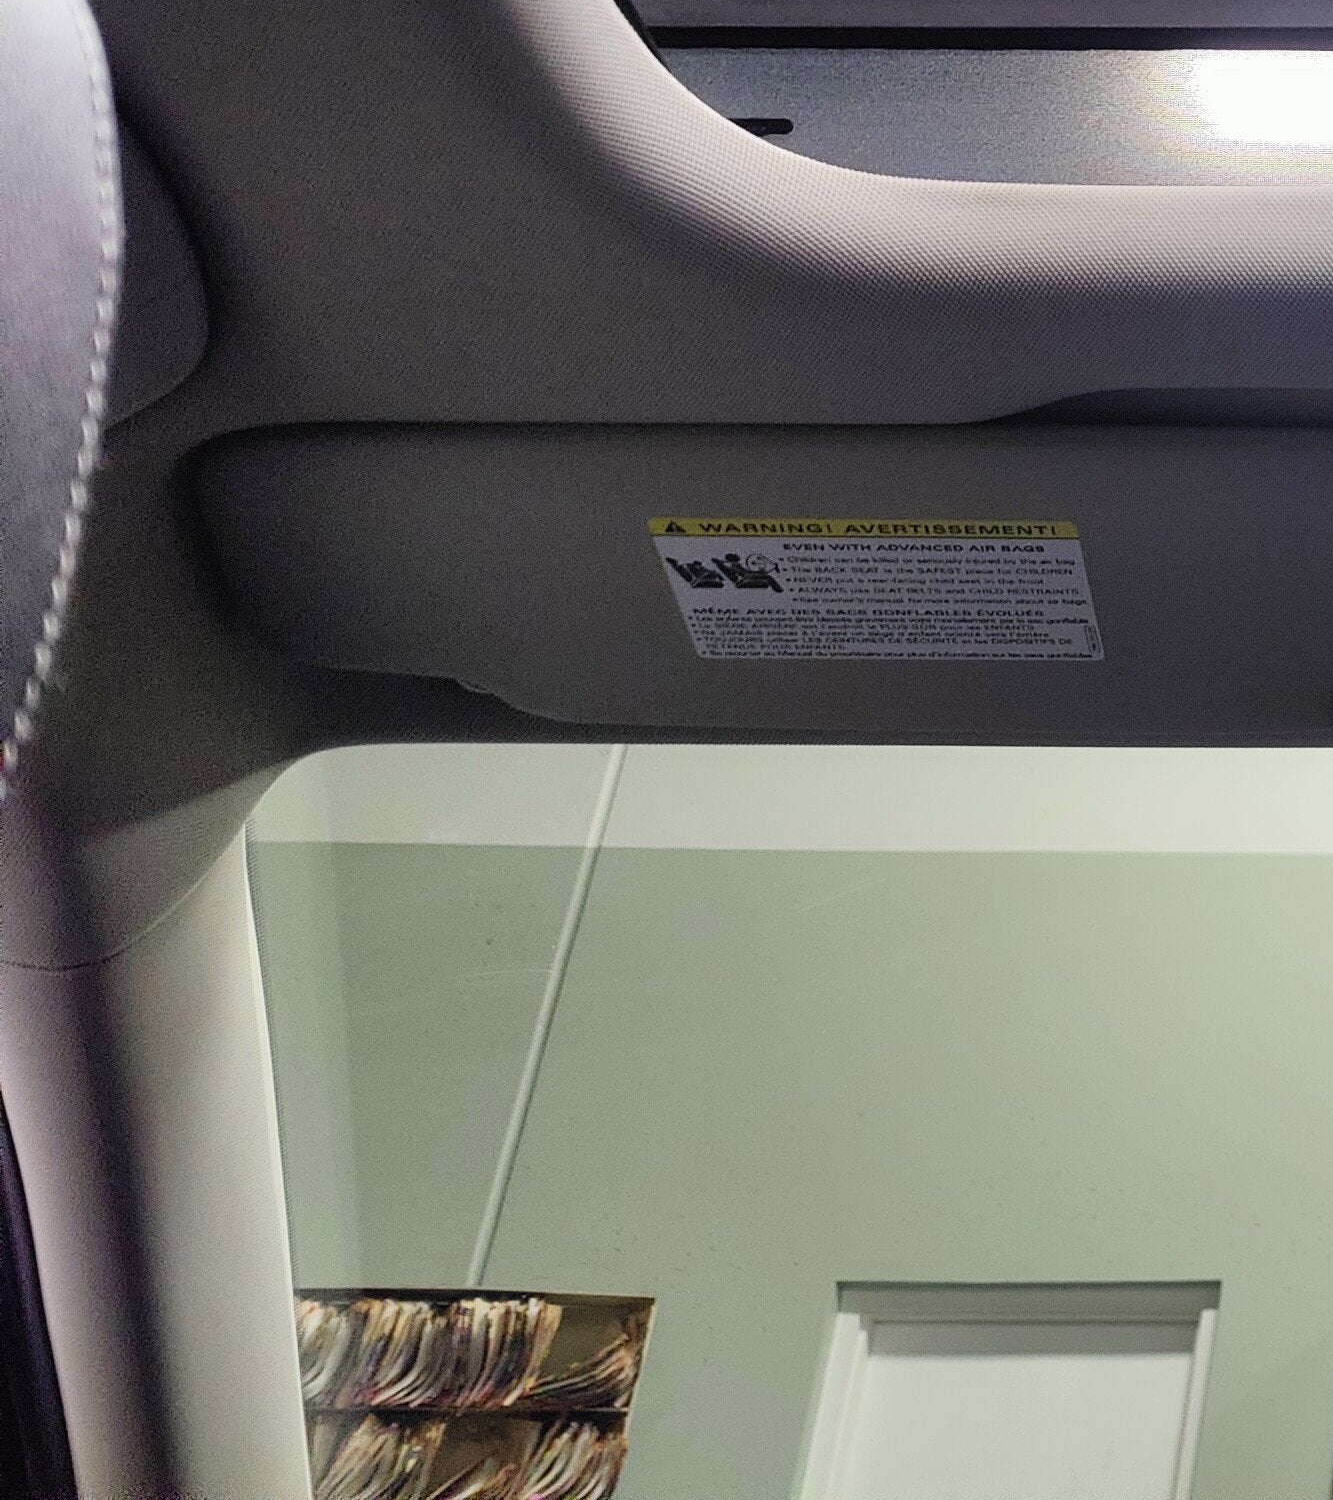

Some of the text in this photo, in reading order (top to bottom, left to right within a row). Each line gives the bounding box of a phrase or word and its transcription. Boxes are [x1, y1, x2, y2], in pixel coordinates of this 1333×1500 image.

[699, 523, 1056, 535] WARNING! AVERTISSEMENT!
[783, 544, 1044, 553] EVEN WITH ADVANCED AIR BAGS
